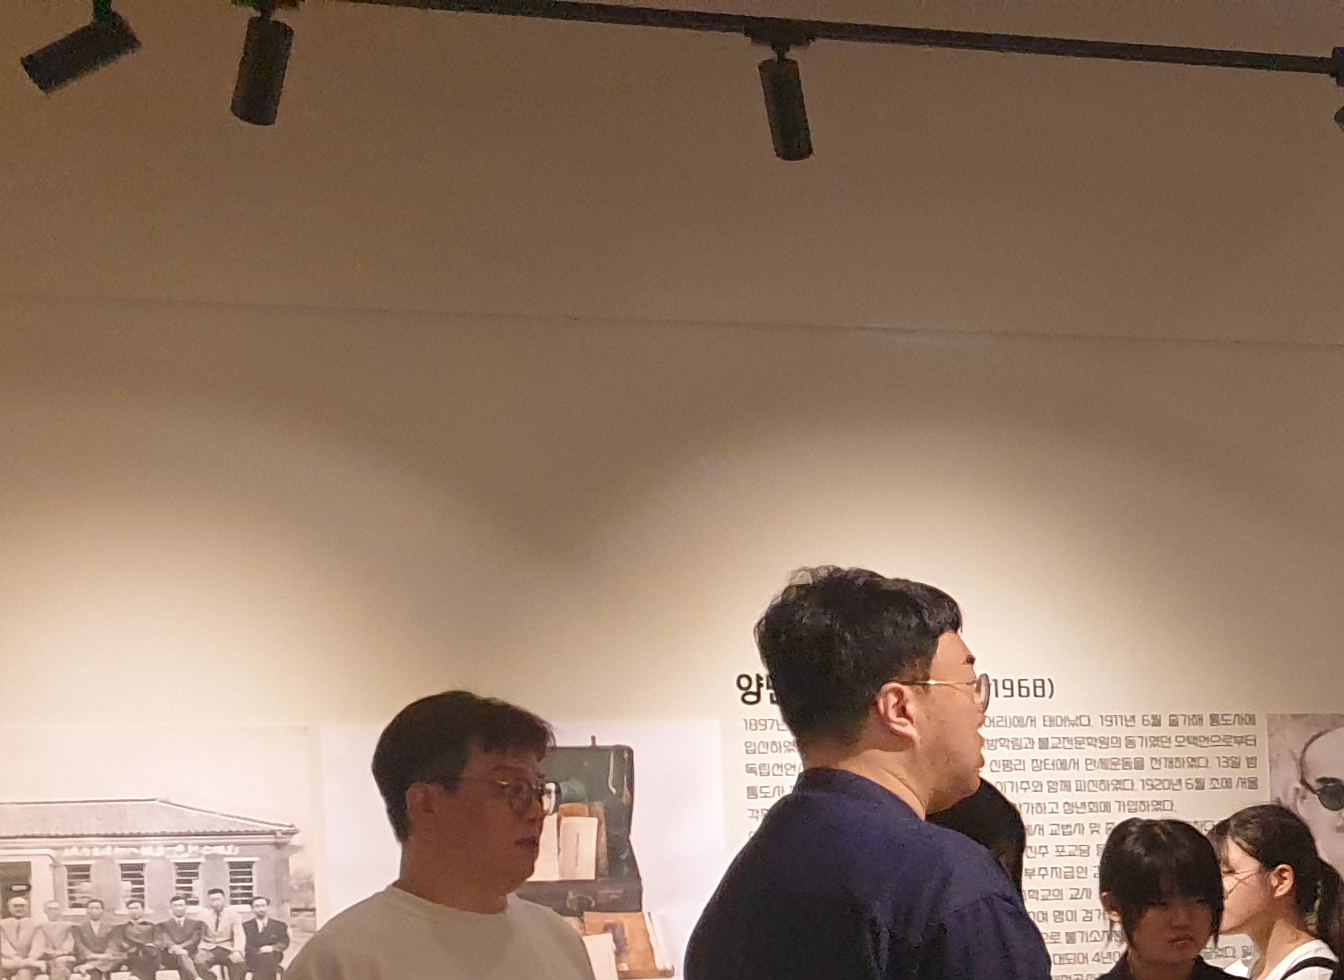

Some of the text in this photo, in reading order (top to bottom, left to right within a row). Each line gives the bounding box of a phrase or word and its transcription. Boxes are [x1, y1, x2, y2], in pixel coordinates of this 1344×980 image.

[993, 677, 1054, 699] 1968)
[985, 715, 1036, 729] 어리)에서
[1099, 714, 1136, 727] 1911년
[1141, 714, 1162, 727] 6월
[1209, 713, 1257, 727] 통도사에
[744, 740, 797, 755] 입산하였
[985, 736, 1034, 751] 방학림과
[1125, 735, 1172, 749] 동기였던
[1175, 733, 1257, 748] 오택언으로부터
[745, 763, 803, 777] 독립선언
[989, 758, 1026, 772] 신평리
[1030, 757, 1080, 772] 장터에서
[1085, 757, 1145, 771] 만세운동을
[1150, 755, 1211, 770] 전개하였다.
[1216, 755, 1241, 768] 13일
[746, 785, 785, 800] 통도사
[1047, 779, 1072, 793] 함께
[1141, 778, 1182, 791] 1920년
[1185, 777, 1206, 791] 6월
[1209, 777, 1233, 791] 초에
[1235, 776, 1259, 790] 서울
[1018, 802, 1058, 815] 가하고
[1117, 799, 1176, 813] 가입하였다.
[1049, 822, 1085, 836] 교법사
[1054, 844, 1091, 858] 포교당
[1024, 887, 1092, 901] 학교의 교사
[1053, 909, 1077, 923] 명이
[1082, 908, 1105, 922] 검거
[1043, 931, 1062, 944] 으로
